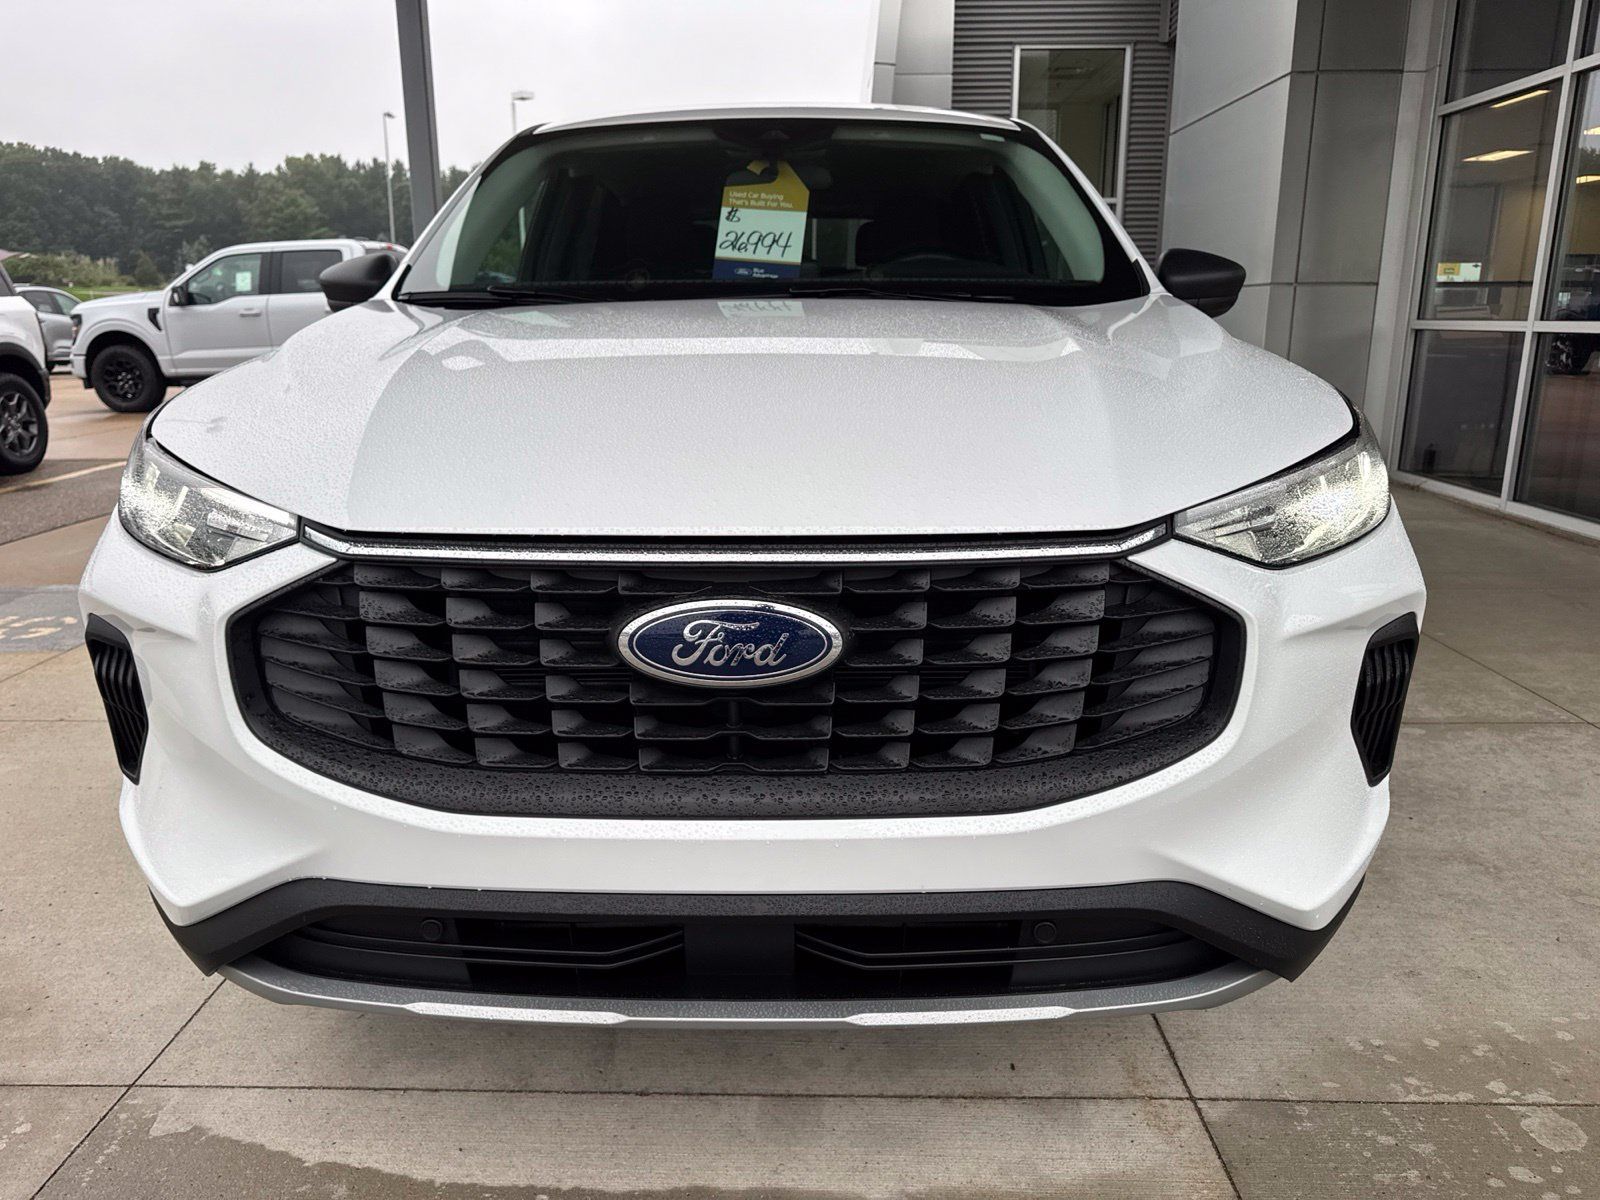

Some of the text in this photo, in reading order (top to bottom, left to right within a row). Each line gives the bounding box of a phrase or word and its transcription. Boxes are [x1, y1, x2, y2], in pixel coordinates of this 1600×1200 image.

[729, 191, 747, 199] Used
[760, 192, 784, 201] Buying
[729, 198, 749, 206] That's
[671, 619, 790, 667] Ford
